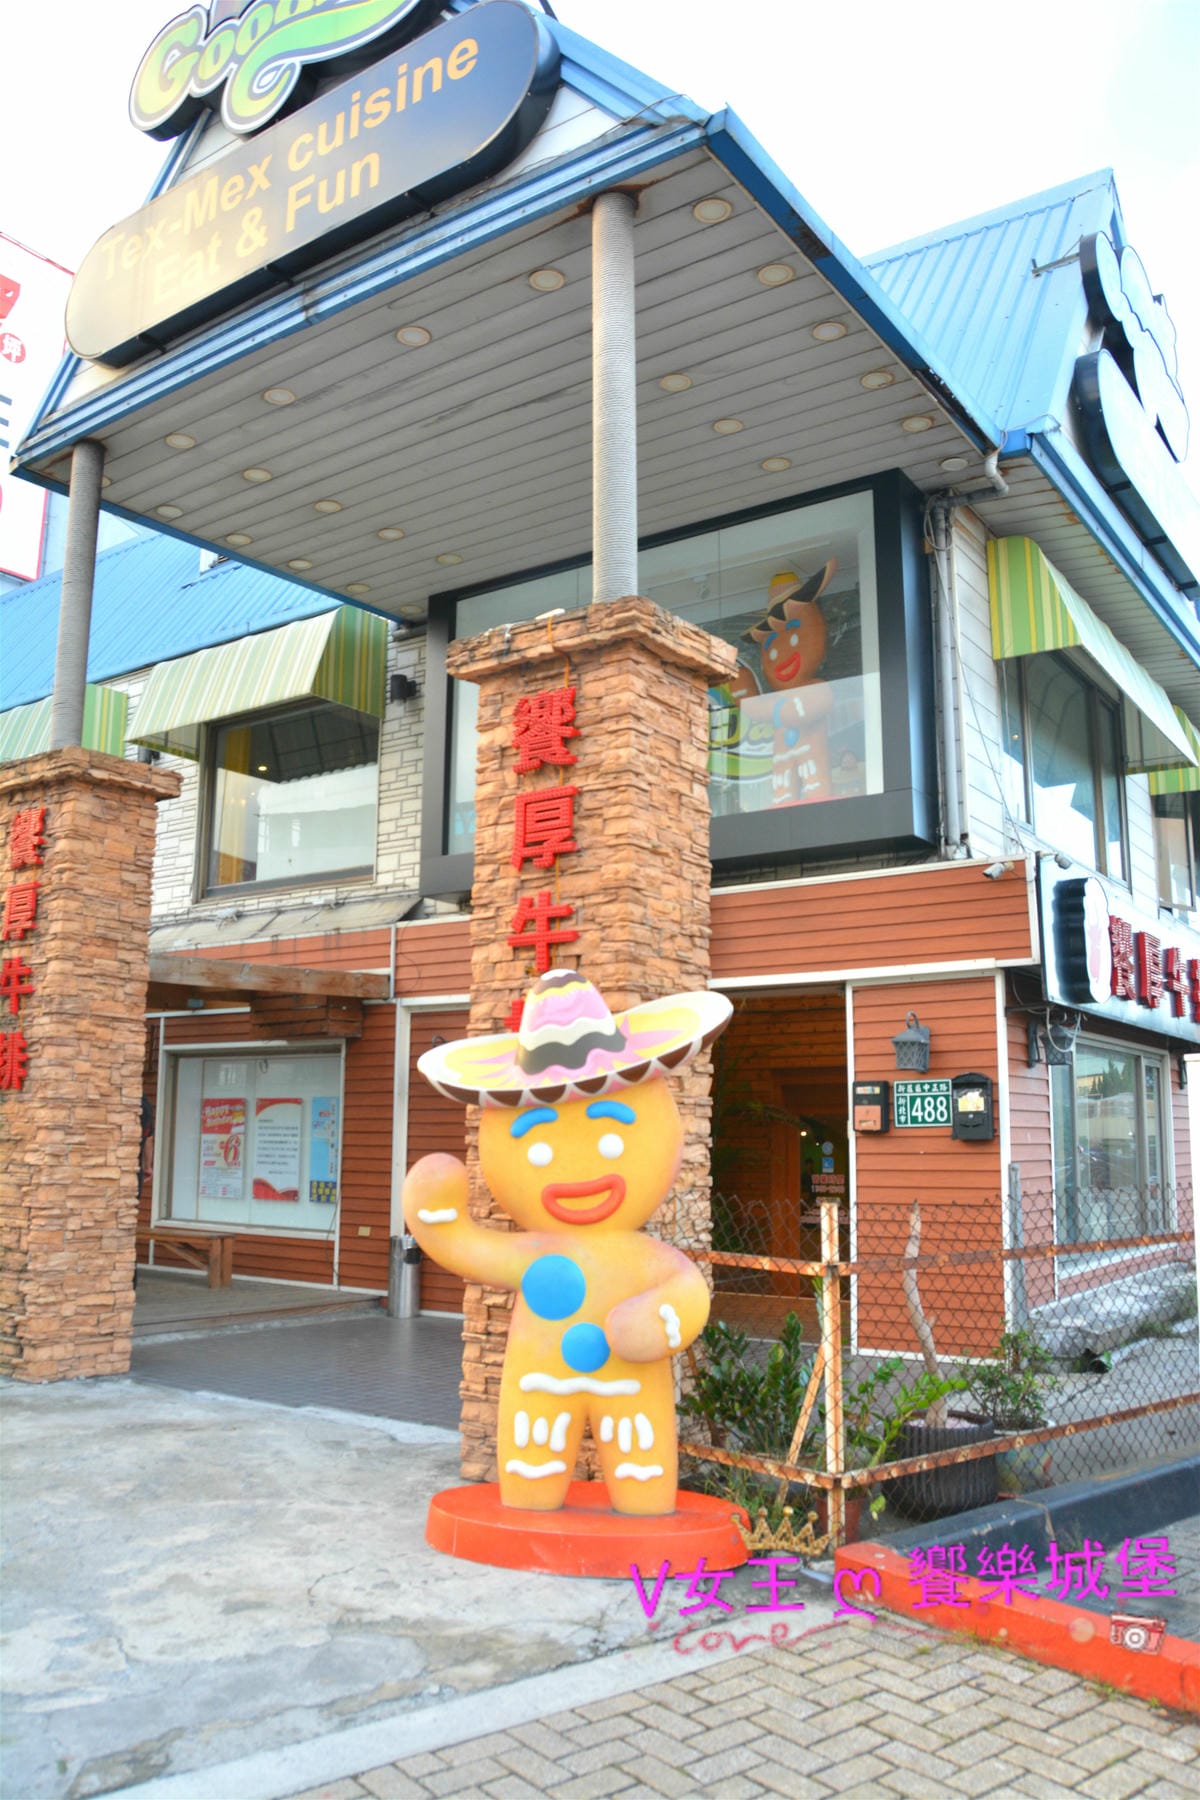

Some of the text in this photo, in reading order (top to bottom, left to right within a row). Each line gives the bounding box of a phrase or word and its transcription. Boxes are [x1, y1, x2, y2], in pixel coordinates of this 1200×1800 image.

[101, 37, 479, 281] Tex-Mex cuisine
[153, 152, 380, 305] Eat & Fun
[911, 1096, 948, 1122] 488
